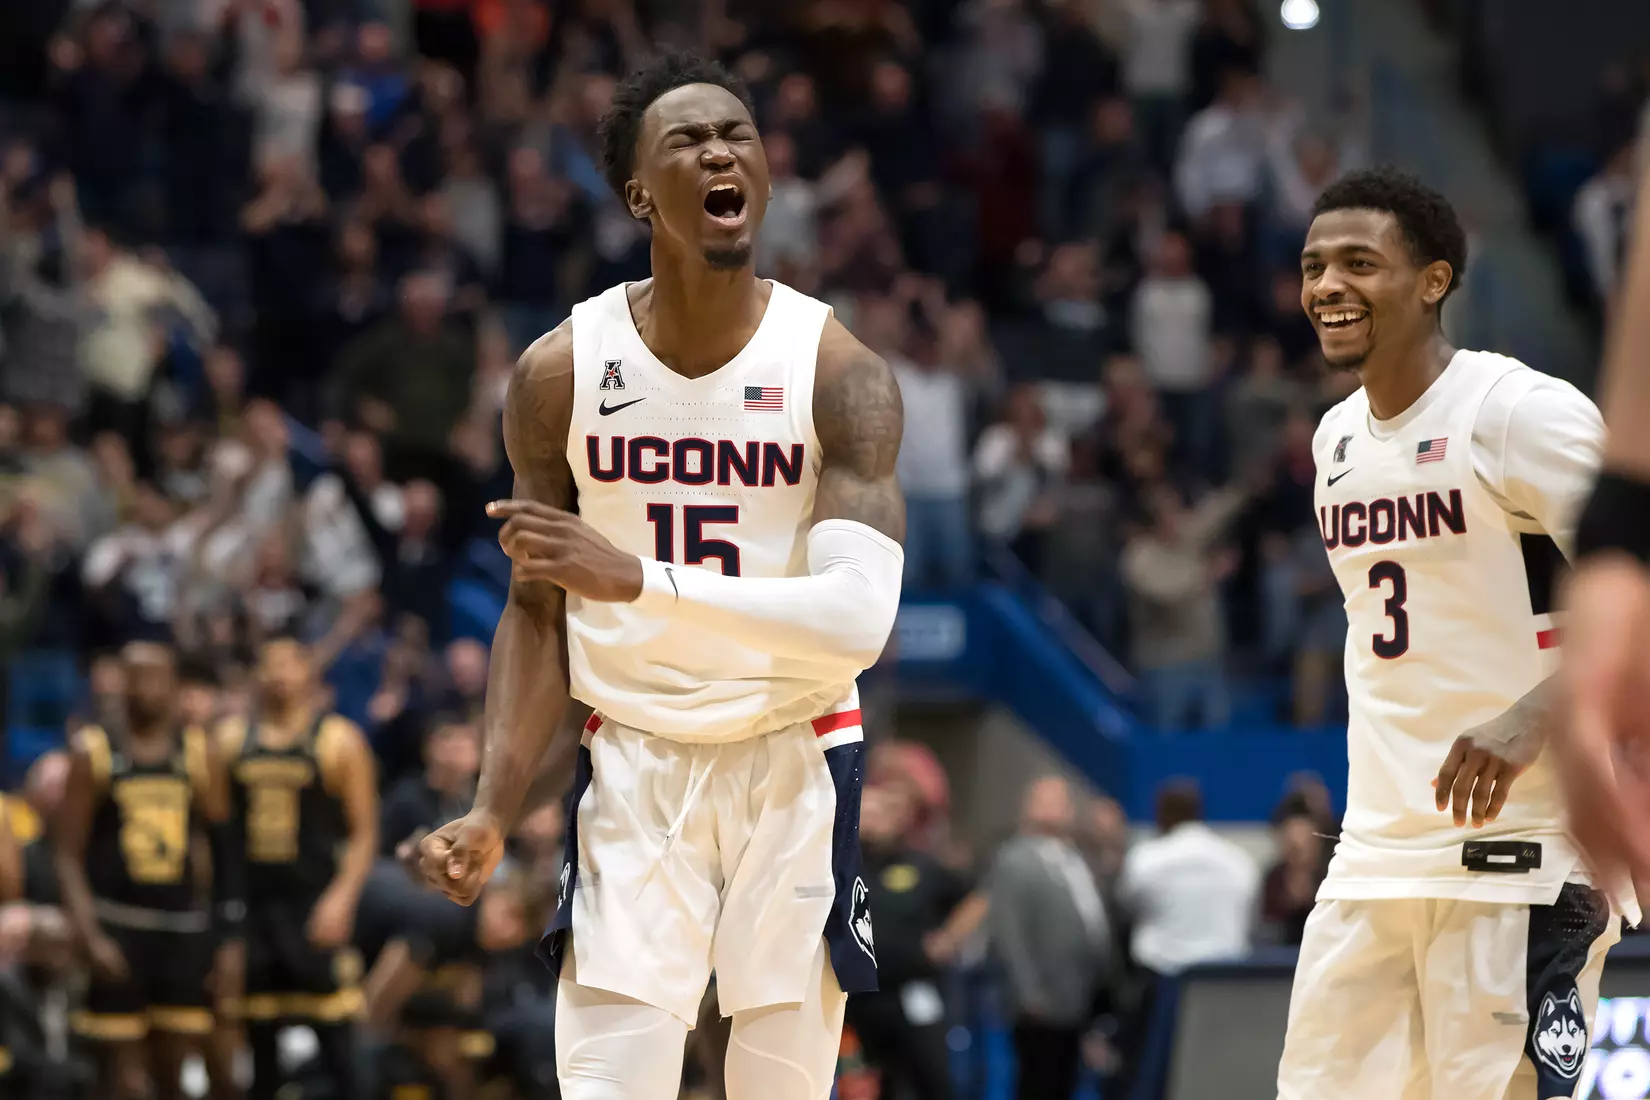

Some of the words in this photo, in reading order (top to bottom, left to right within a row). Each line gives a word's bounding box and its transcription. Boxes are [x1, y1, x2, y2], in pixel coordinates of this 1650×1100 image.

[586, 435, 804, 487] UCONN
[646, 503, 740, 578] 15
[1320, 489, 1467, 551] UCONN
[1368, 560, 1409, 660] 3
